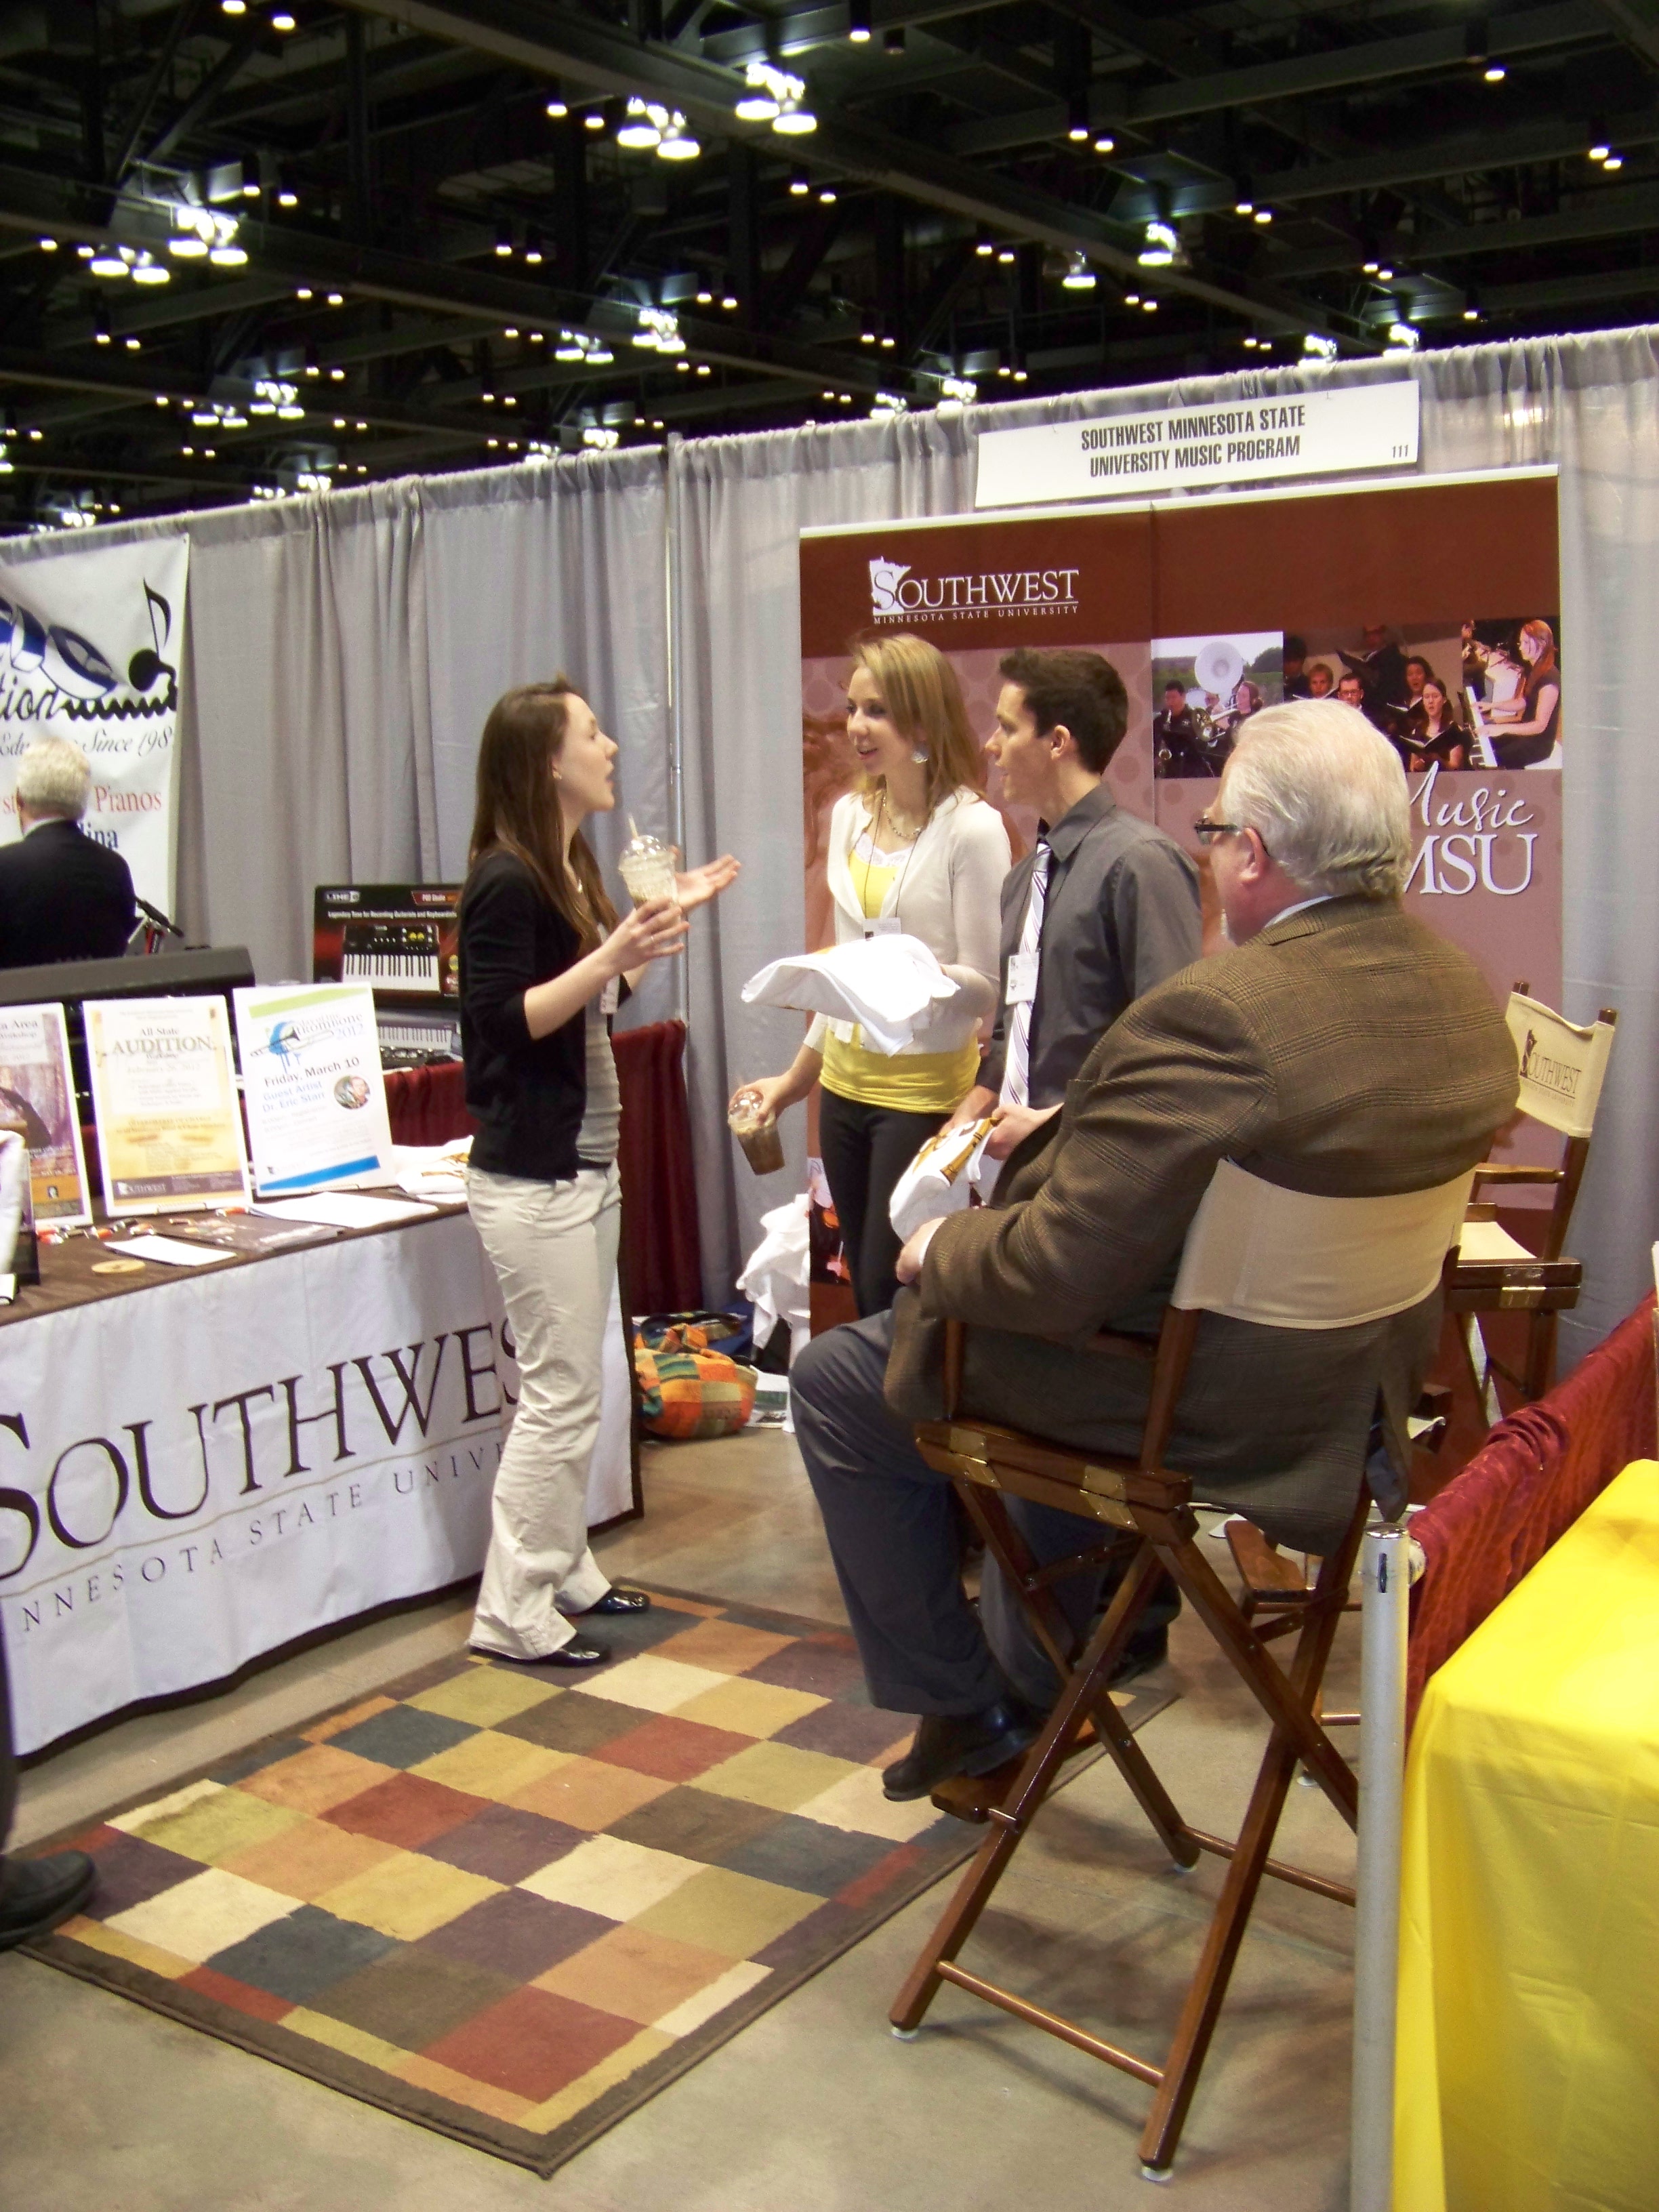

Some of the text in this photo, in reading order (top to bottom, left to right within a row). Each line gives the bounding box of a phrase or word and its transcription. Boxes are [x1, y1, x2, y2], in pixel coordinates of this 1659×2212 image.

[1081, 405, 1306, 451] SOUTHWEST MINNESOTA STATE
[1090, 434, 1301, 478] UNIVERSITY MUSIC PROGRAM
[1392, 444, 1409, 459] 111
[874, 569, 1080, 610] SOUTHWEST
[874, 605, 1080, 625] MINNESOTA STATE UNIVERSITY
[83, 727, 133, 753] Since
[94, 785, 162, 813] Pianos
[337, 1023, 365, 1040] 2012
[264, 1073, 303, 1088] Friday,
[305, 1062, 342, 1078] March
[1519, 1038, 1582, 1094] SOUTHWEST
[263, 1080, 323, 1101] Guest Artist
[250, 1482, 362, 1545] STATE
